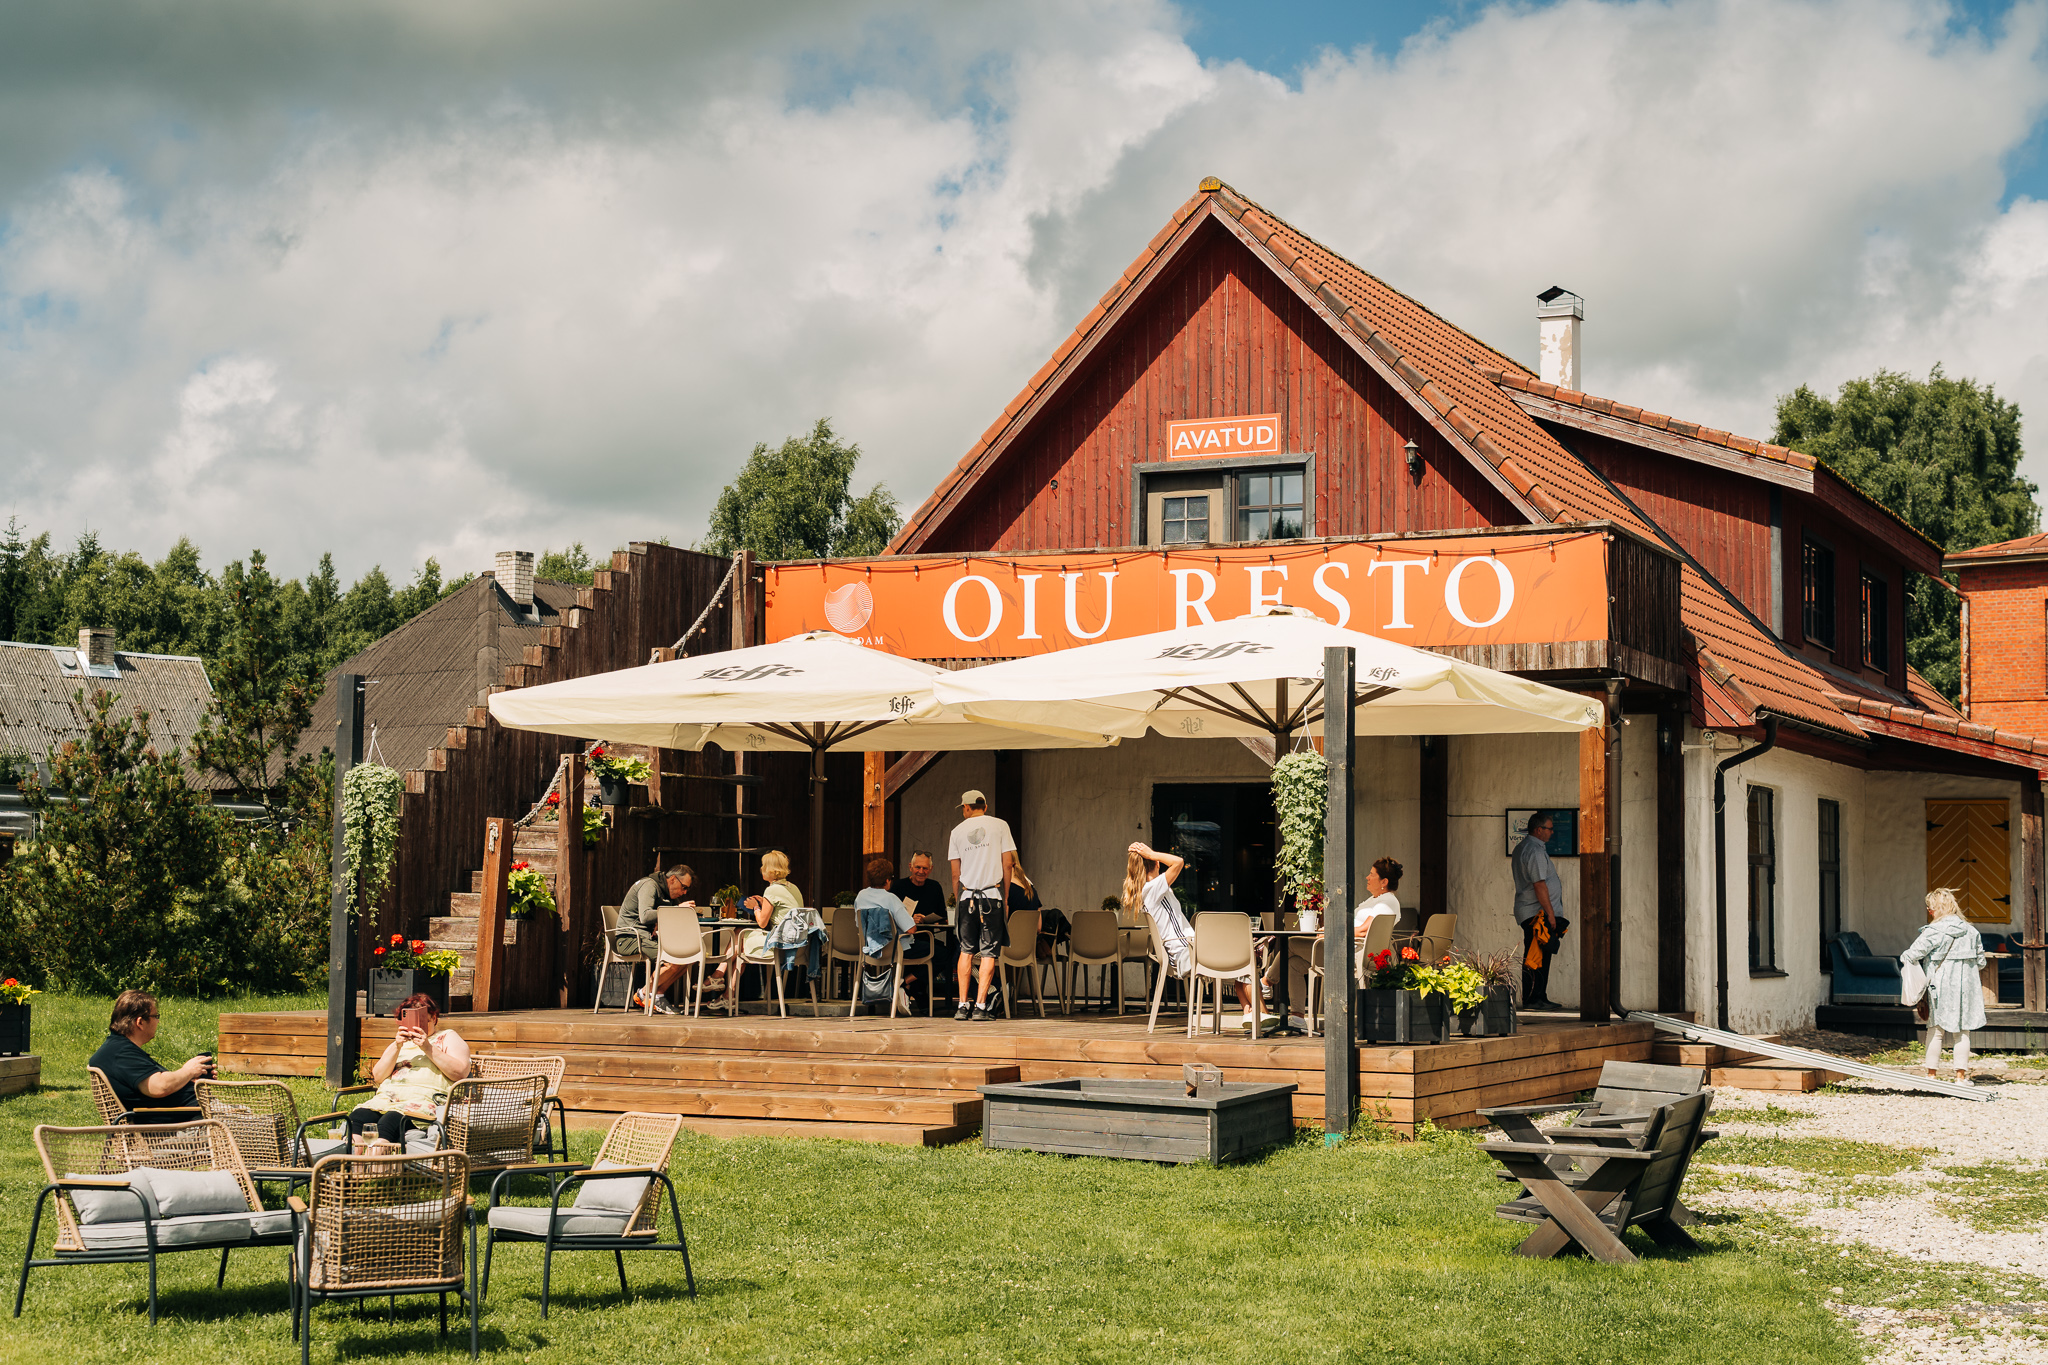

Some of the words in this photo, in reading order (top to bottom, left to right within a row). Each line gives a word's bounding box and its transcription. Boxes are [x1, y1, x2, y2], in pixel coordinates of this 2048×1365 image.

[1174, 425, 1274, 451] AVATUD
[942, 571, 1120, 643] OIU
[1169, 556, 1516, 631] RESTO
[1153, 641, 1275, 661] Leffe
[695, 664, 805, 682] Leffe
[1368, 667, 1400, 682] Leffe
[889, 696, 916, 715] Leffe
